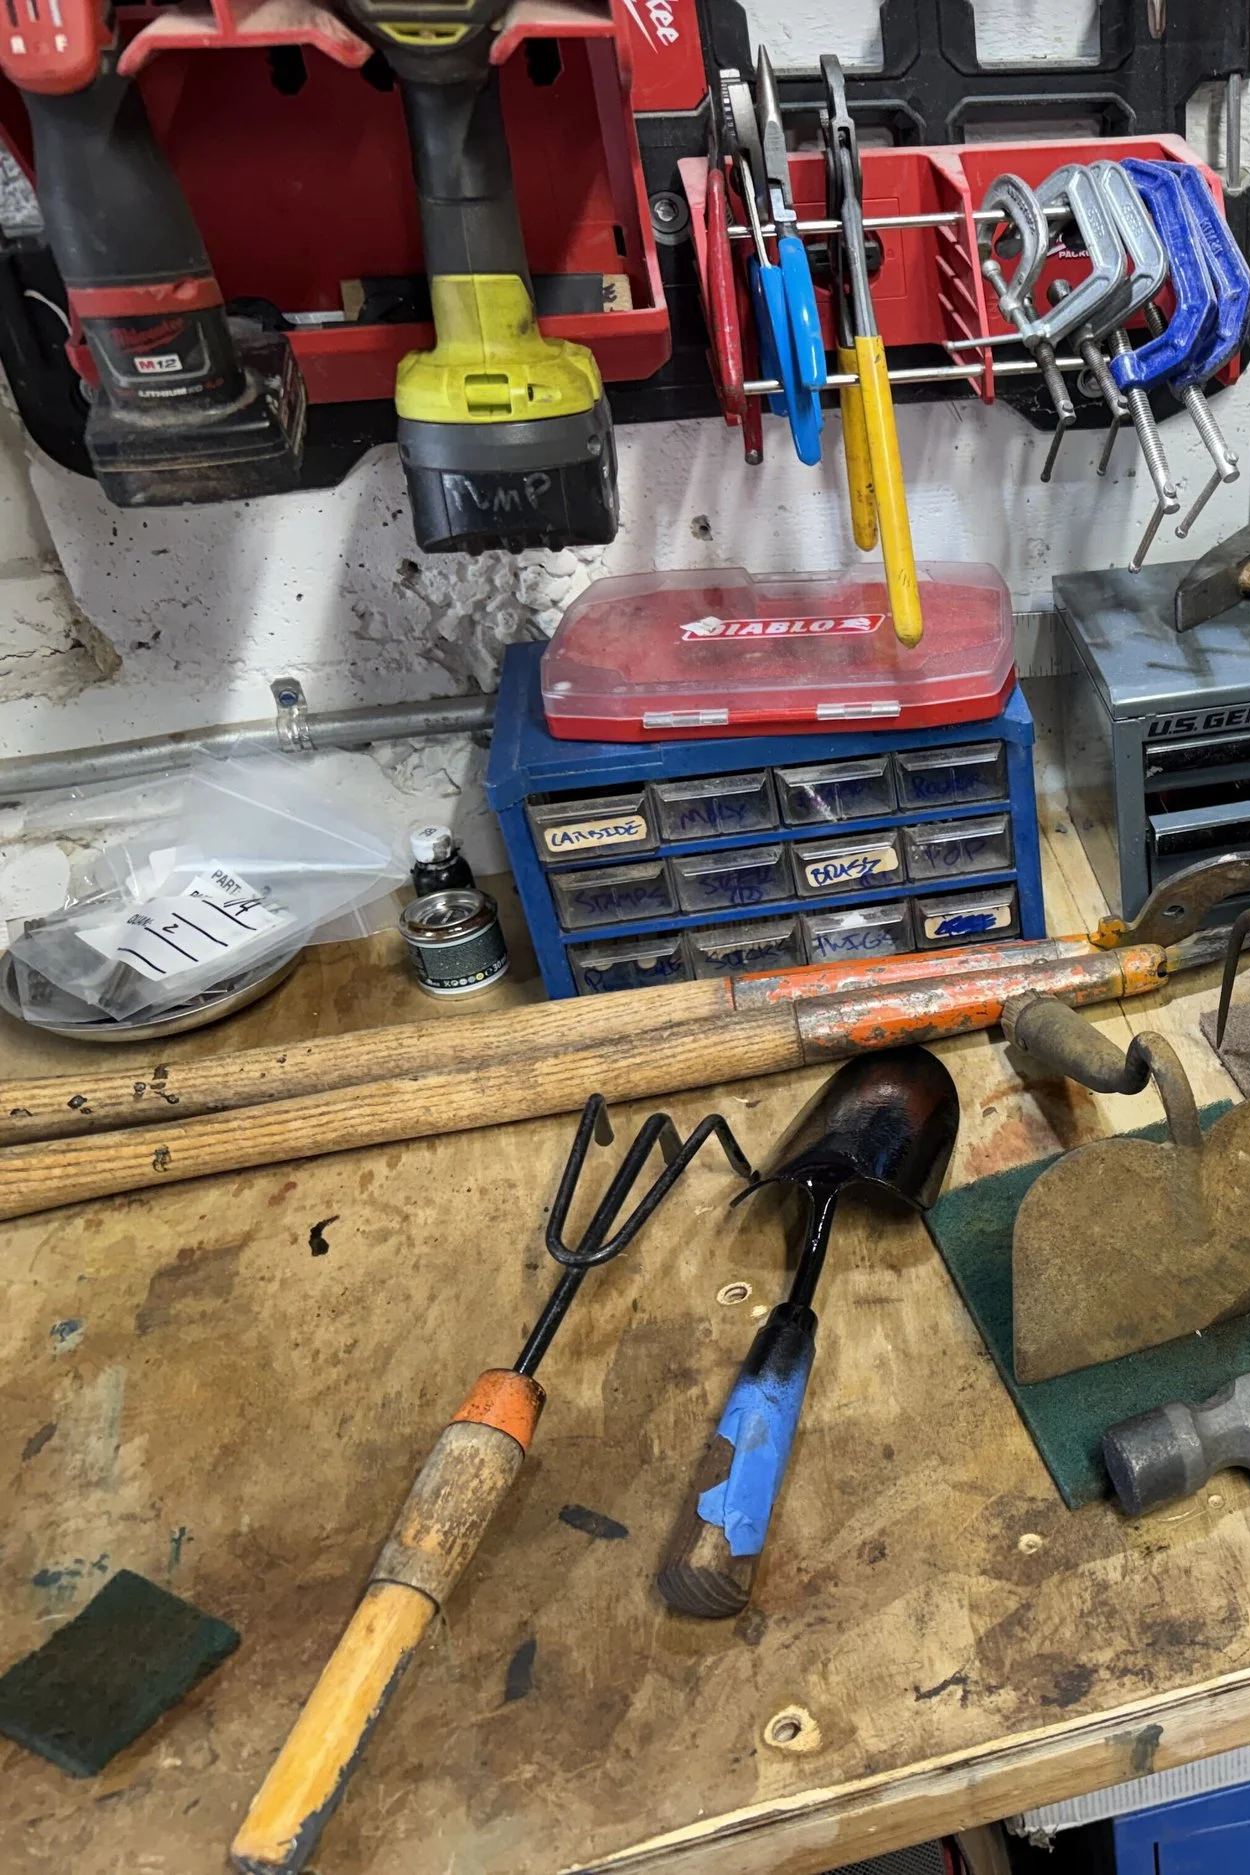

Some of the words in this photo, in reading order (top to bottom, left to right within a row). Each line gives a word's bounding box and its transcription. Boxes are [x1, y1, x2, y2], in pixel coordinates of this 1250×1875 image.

[137, 357, 178, 370] M12
[708, 618, 835, 637] DIABLO
[1147, 715, 1198, 738] U.S.
